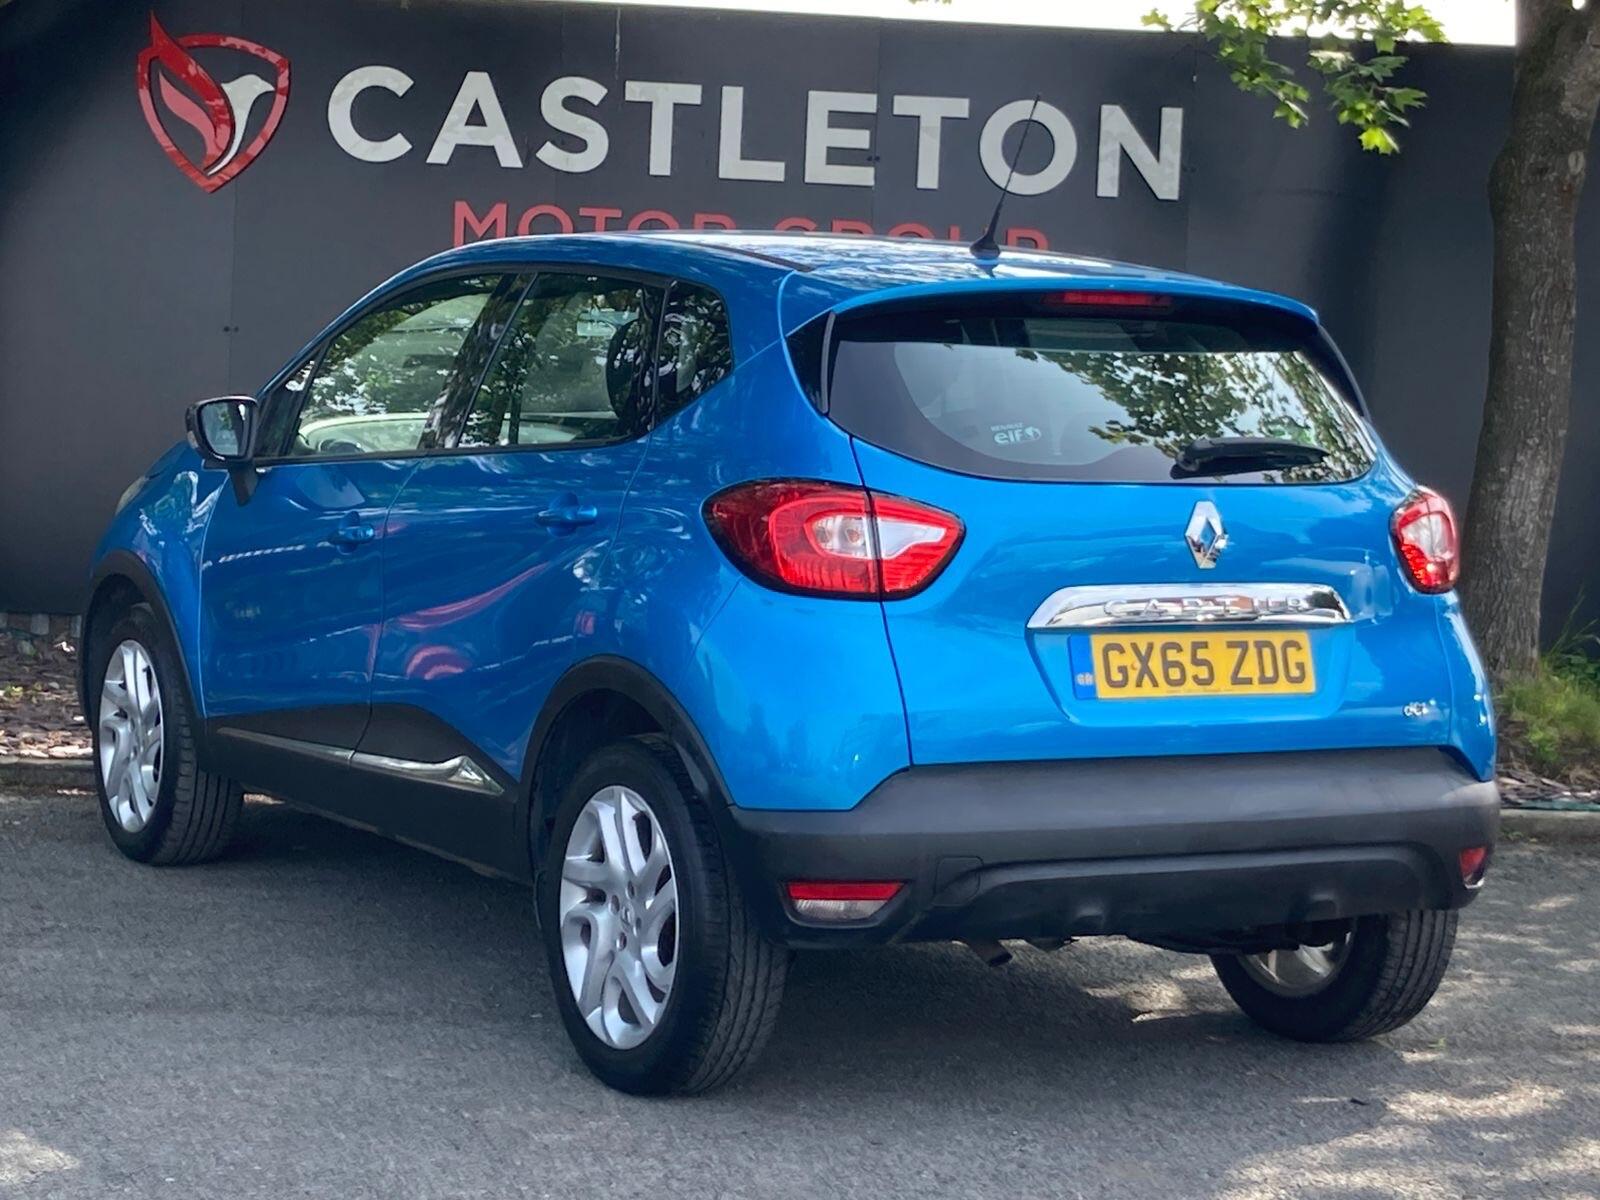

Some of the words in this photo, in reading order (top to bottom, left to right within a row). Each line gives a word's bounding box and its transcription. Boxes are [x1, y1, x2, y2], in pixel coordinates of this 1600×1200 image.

[328, 65, 1183, 200] CASTLETON
[1102, 641, 1215, 688] GX65
[1226, 639, 1306, 685] ZDG
